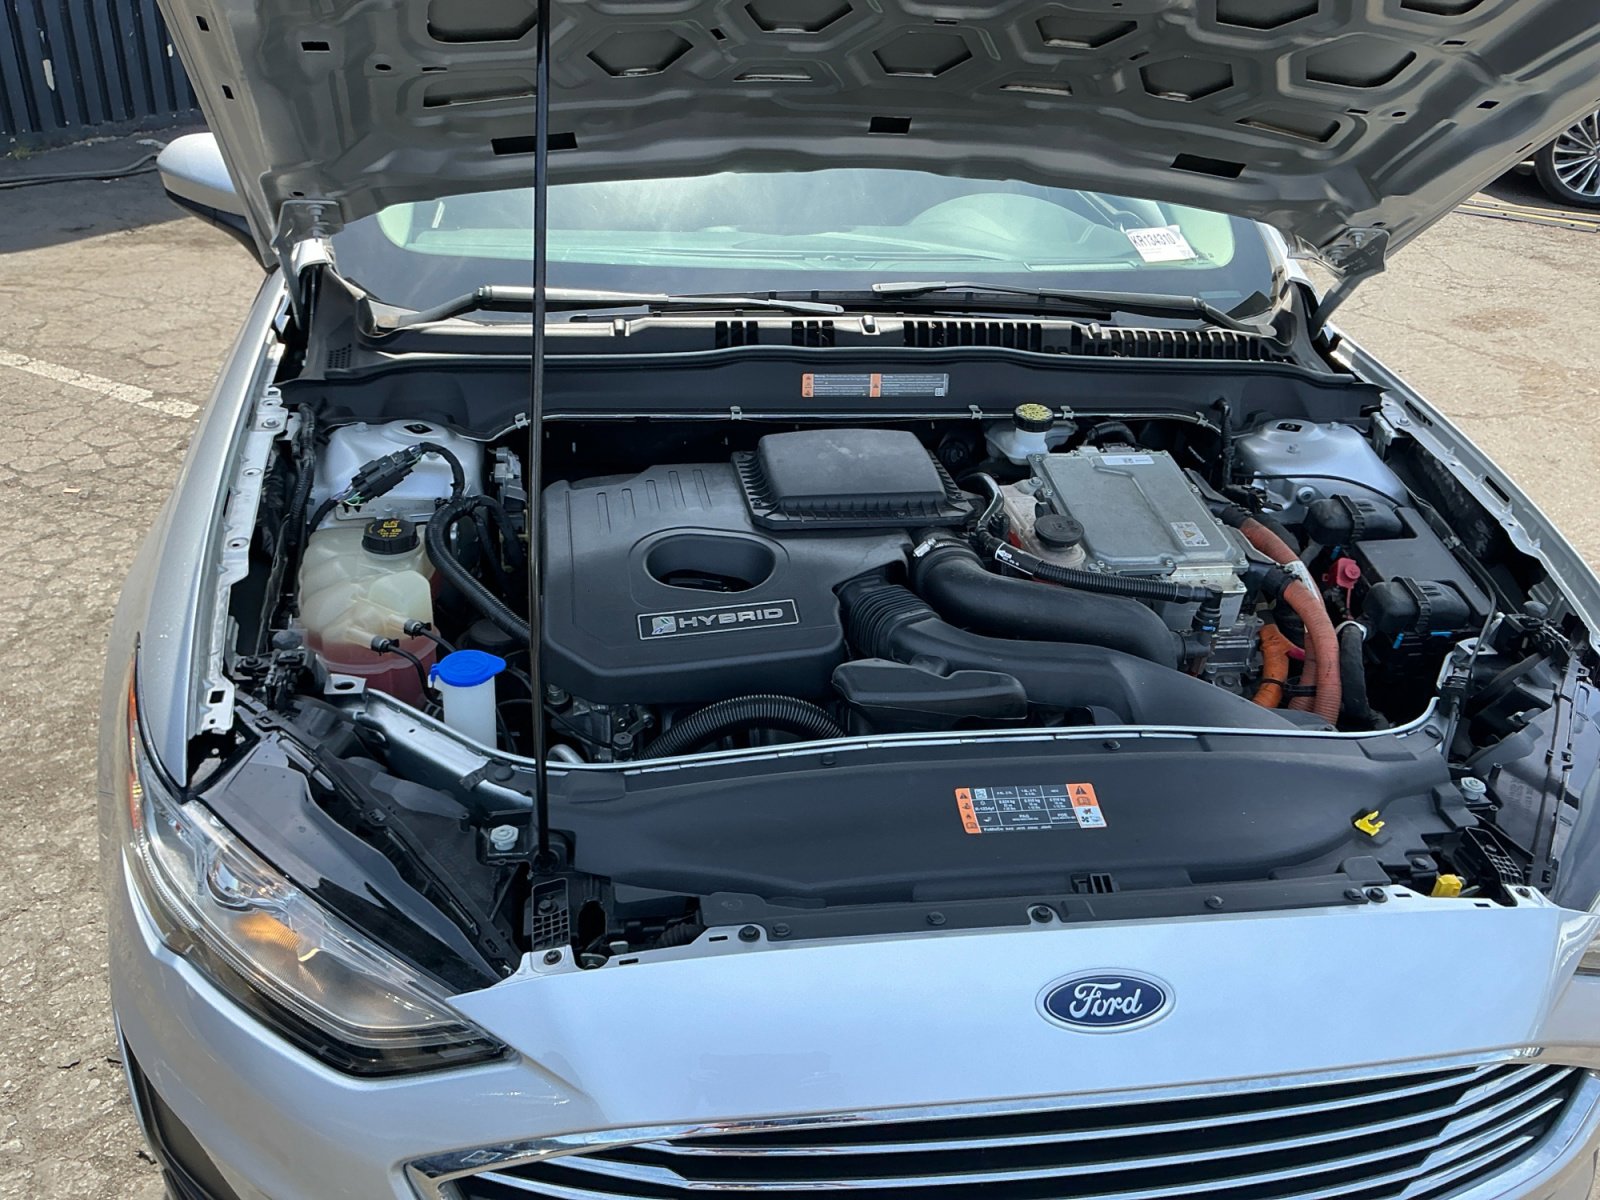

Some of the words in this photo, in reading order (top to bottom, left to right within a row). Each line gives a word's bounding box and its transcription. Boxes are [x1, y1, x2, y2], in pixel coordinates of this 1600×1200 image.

[1130, 233, 1176, 247] KR134310
[679, 608, 783, 628] HYBRID
[1069, 982, 1142, 1018] Ford
